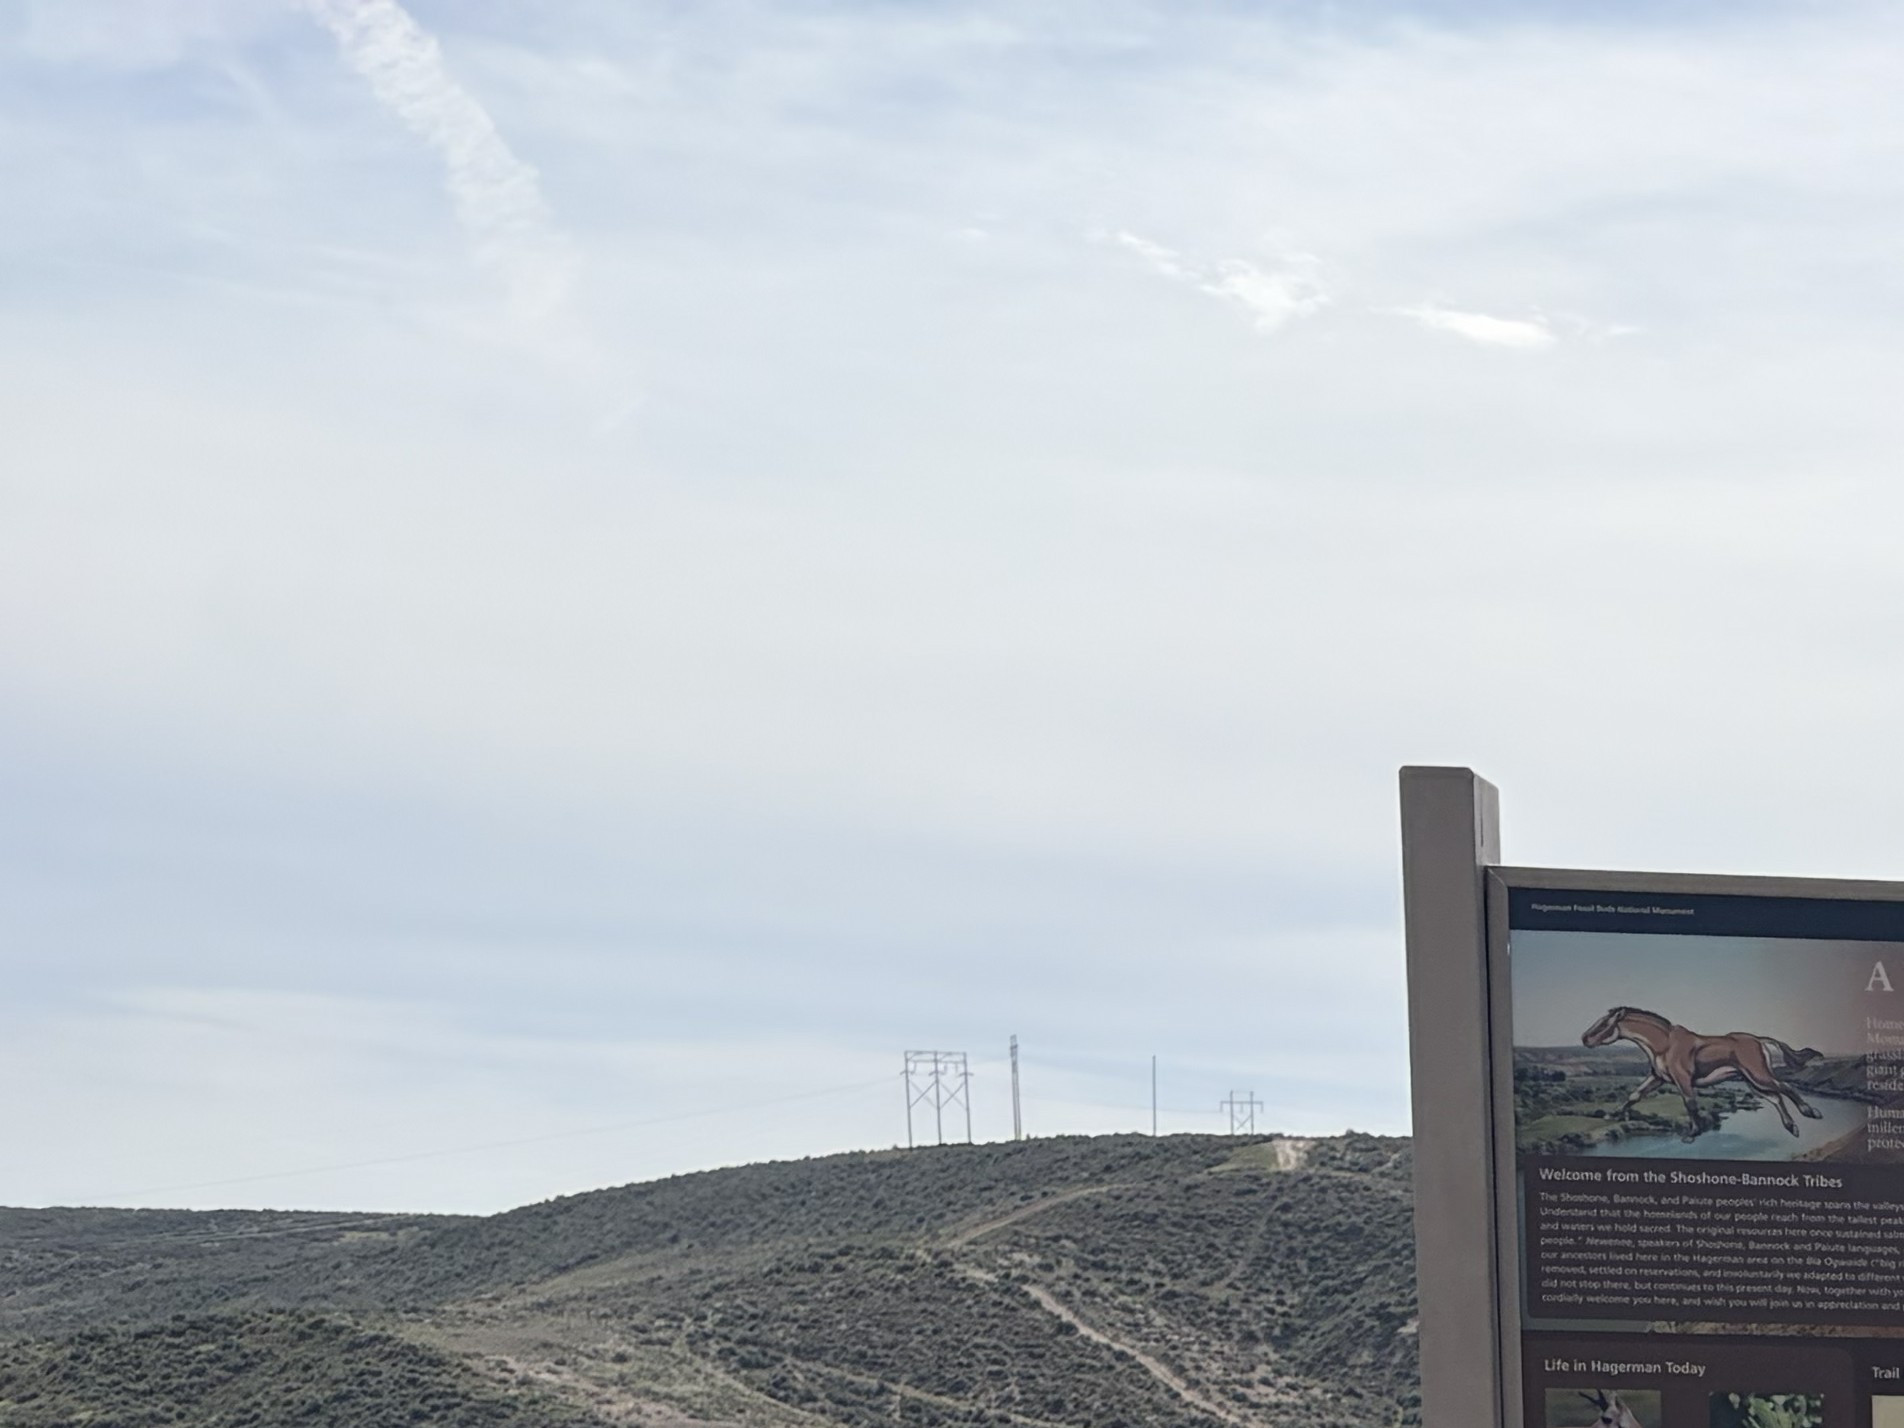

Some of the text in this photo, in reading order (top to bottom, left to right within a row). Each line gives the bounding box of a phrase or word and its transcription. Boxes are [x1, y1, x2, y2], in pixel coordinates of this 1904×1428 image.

[1866, 961, 1893, 992] A
[1866, 1017, 1904, 1032] Home
[1538, 1168, 1843, 1187] Welcome from the Shoshone-Bannock Tribes
[1544, 1359, 1706, 1378] Life in Hagerman Today
[1872, 1366, 1900, 1379] Trail
